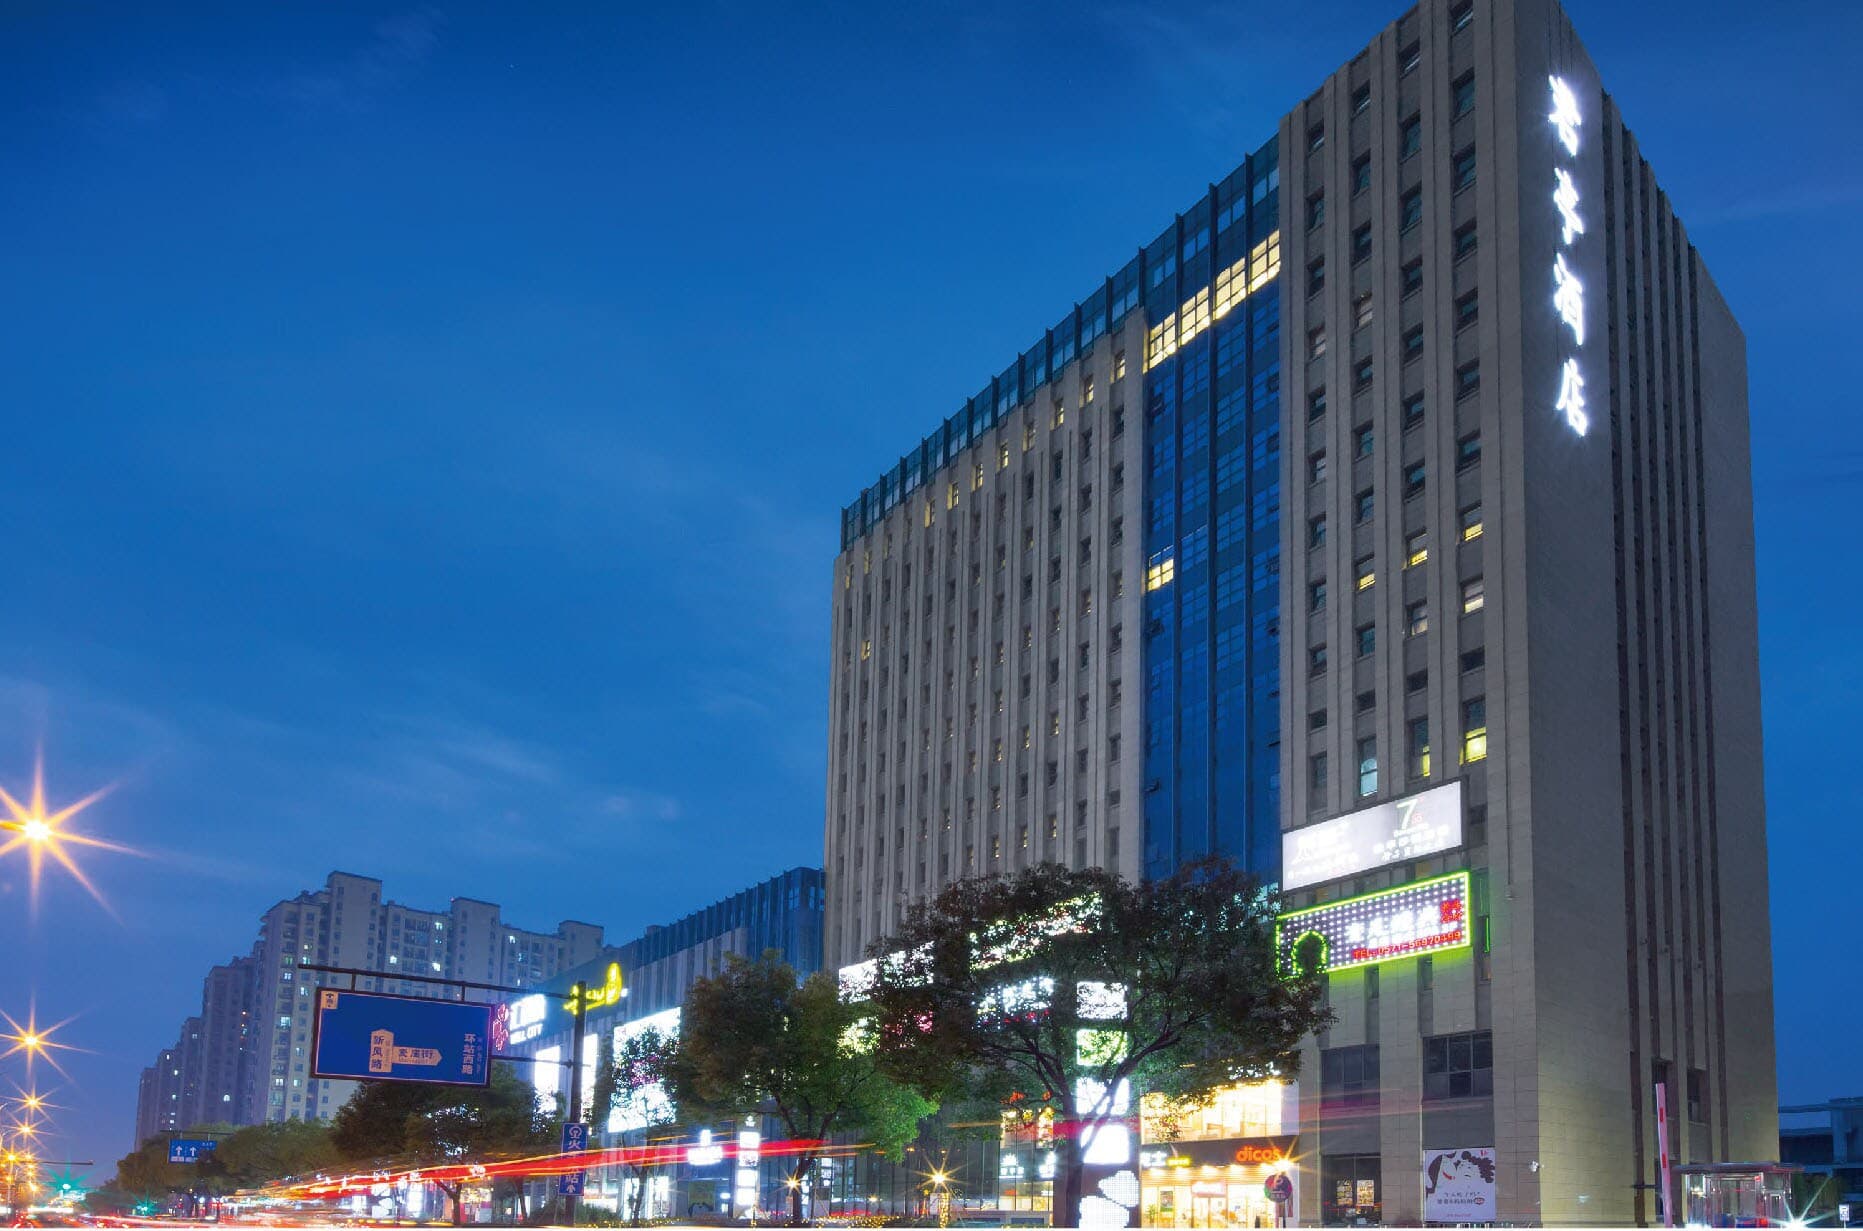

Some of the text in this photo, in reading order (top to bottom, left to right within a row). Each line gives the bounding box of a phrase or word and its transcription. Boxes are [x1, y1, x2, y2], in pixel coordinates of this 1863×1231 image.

[1397, 799, 1418, 829] 7
[527, 1024, 543, 1039] CITY
[371, 1035, 385, 1070] 新风路
[461, 1033, 476, 1075] 环站西路
[565, 1140, 581, 1184] 火站
[1236, 1145, 1281, 1162] dicos
